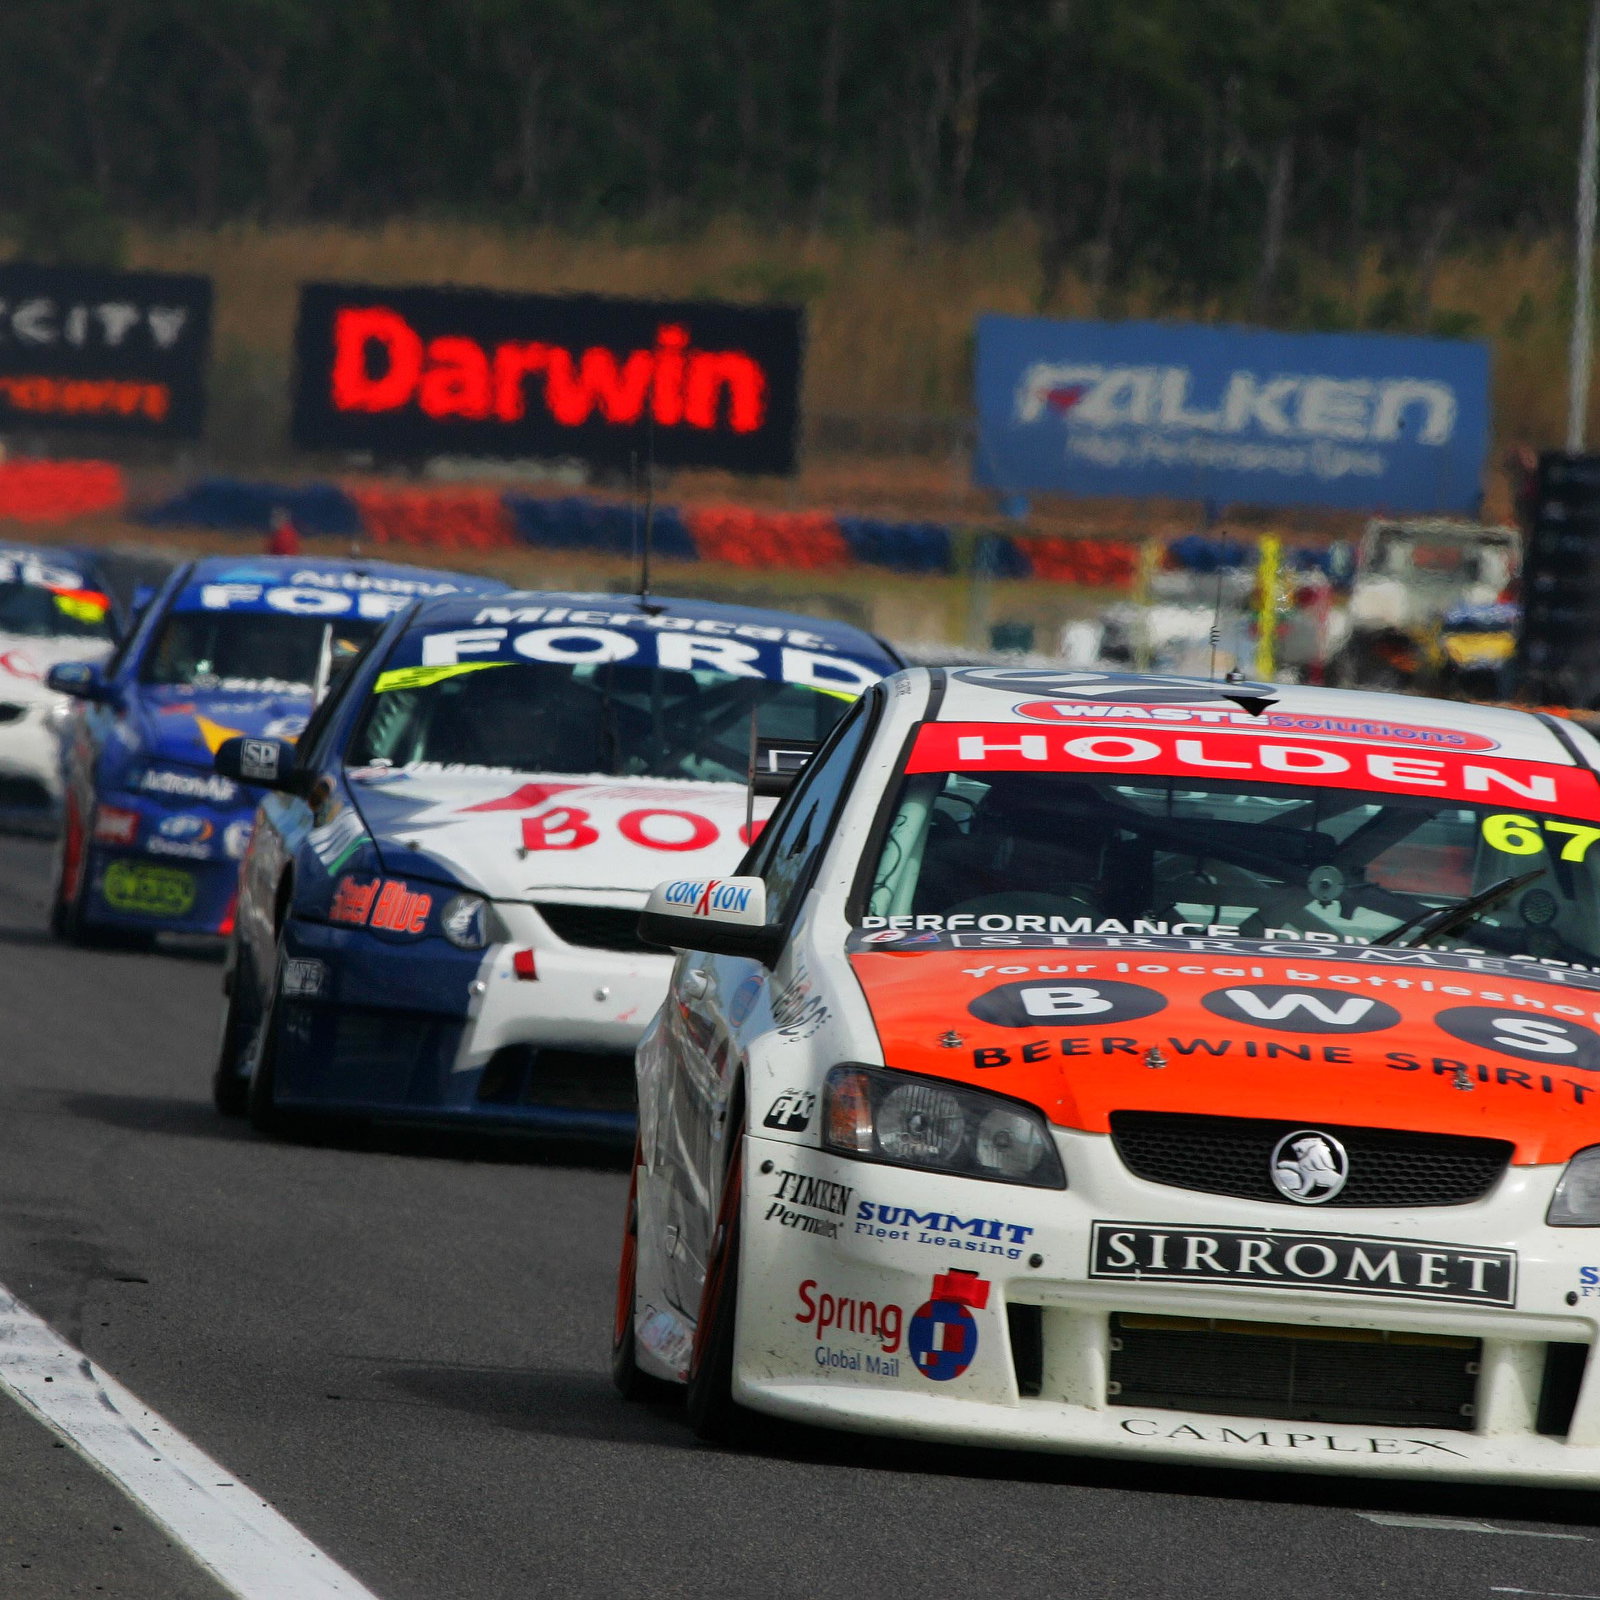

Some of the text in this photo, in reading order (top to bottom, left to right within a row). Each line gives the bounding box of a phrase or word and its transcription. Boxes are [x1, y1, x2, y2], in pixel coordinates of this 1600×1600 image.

[0, 296, 188, 348] CITY
[333, 305, 765, 432] Darwin
[1014, 361, 1457, 446] FALKEN
[202, 582, 412, 620] FOR
[421, 626, 886, 694] FORD
[957, 734, 1558, 803] HOLDEN
[520, 806, 767, 852] BO
[1482, 813, 1600, 864] 67
[370, 880, 432, 934] Blue
[861, 913, 1240, 938] PERFORMANCE
[1116, 962, 1265, 979] local
[1285, 968, 1600, 1024] bottlesho
[1020, 986, 1578, 1054] B W S
[973, 1036, 1140, 1070] BEER
[1167, 1037, 1355, 1065] WINE
[773, 1170, 855, 1216] TIMKEN
[854, 1221, 1024, 1260] Fleet Leasing
[857, 1200, 1034, 1245] SUMMIT
[1105, 1231, 1502, 1294] SIRROMET
[794, 1279, 903, 1354] Spring
[814, 1345, 900, 1378] Global Mail
[1120, 1418, 1470, 1459] CAMPLEX
